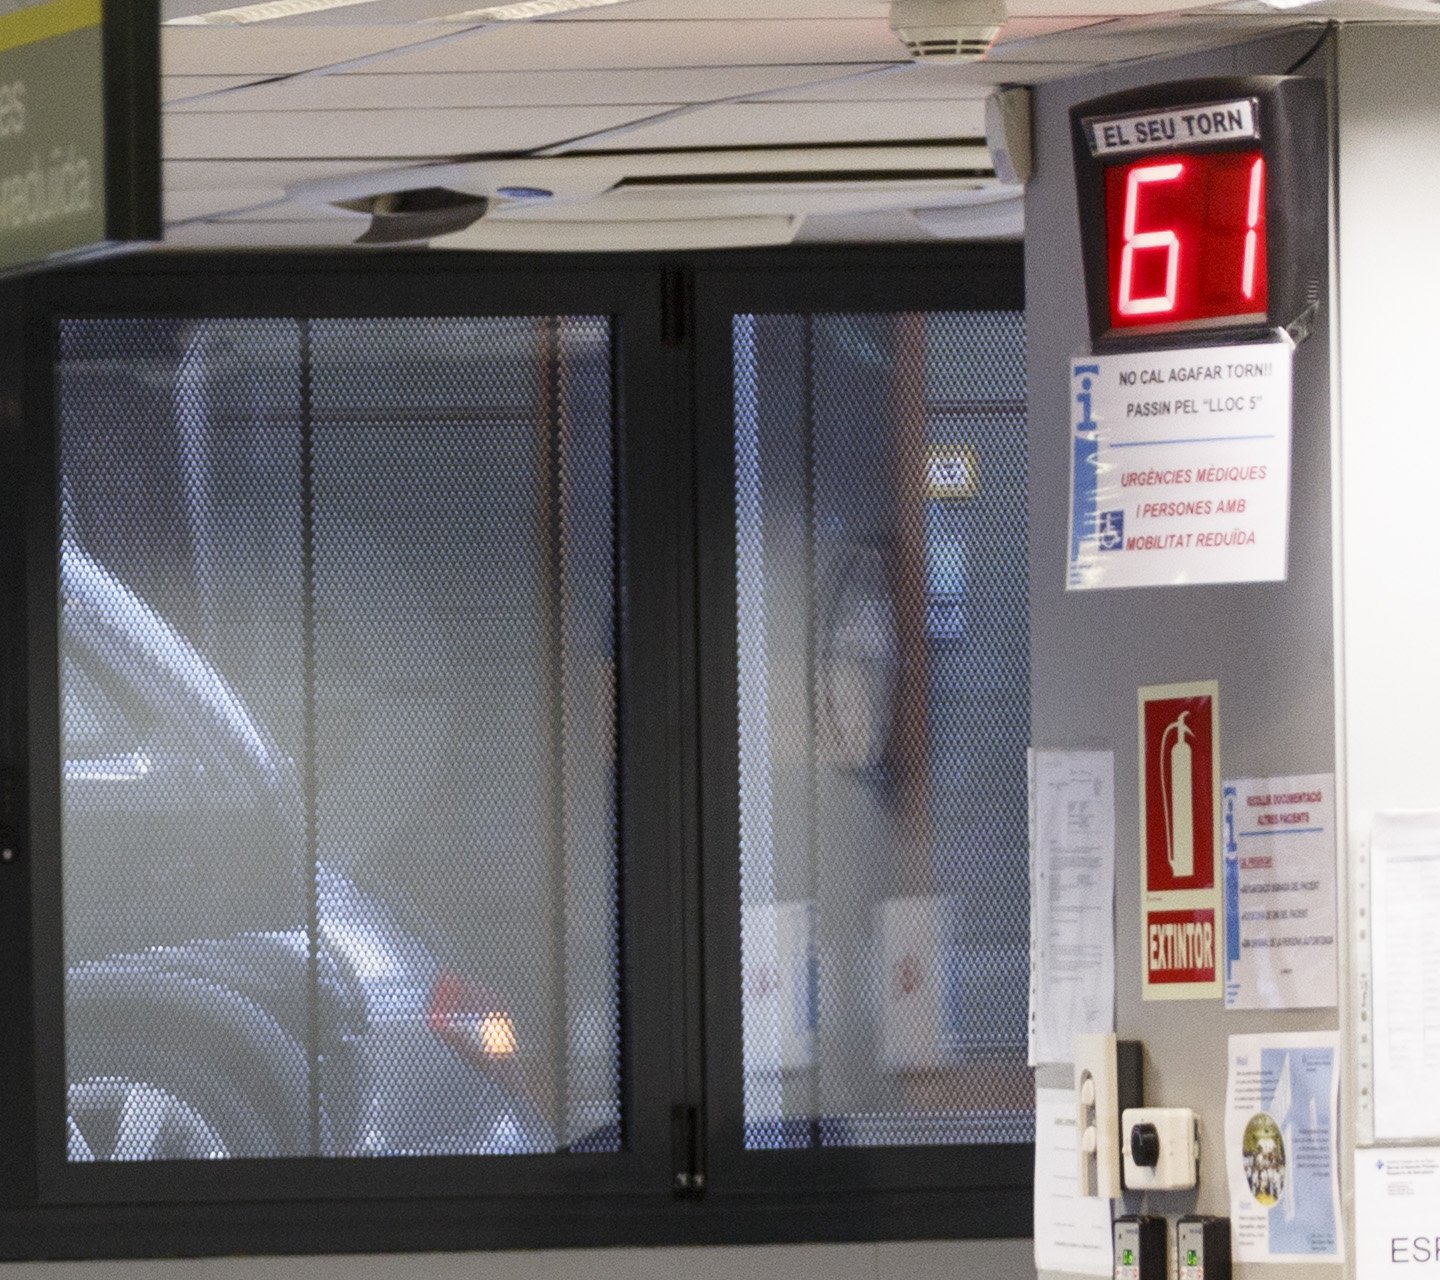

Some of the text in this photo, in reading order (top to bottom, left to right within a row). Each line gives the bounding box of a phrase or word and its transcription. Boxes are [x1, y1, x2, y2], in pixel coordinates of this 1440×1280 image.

[1103, 108, 1244, 148] EL SEU TORN
[1119, 157, 1264, 314] 61
[1119, 363, 1273, 386] NO CAL AGAFAR TORN!!
[1126, 401, 1171, 418] PASSIN
[1174, 400, 1198, 414] PEL
[1142, 500, 1212, 518] PERSONES
[1216, 499, 1246, 514] AMB
[1125, 528, 1256, 551] MOBILITAT REDUÏDA
[1149, 922, 1214, 970] EXTINTOR
